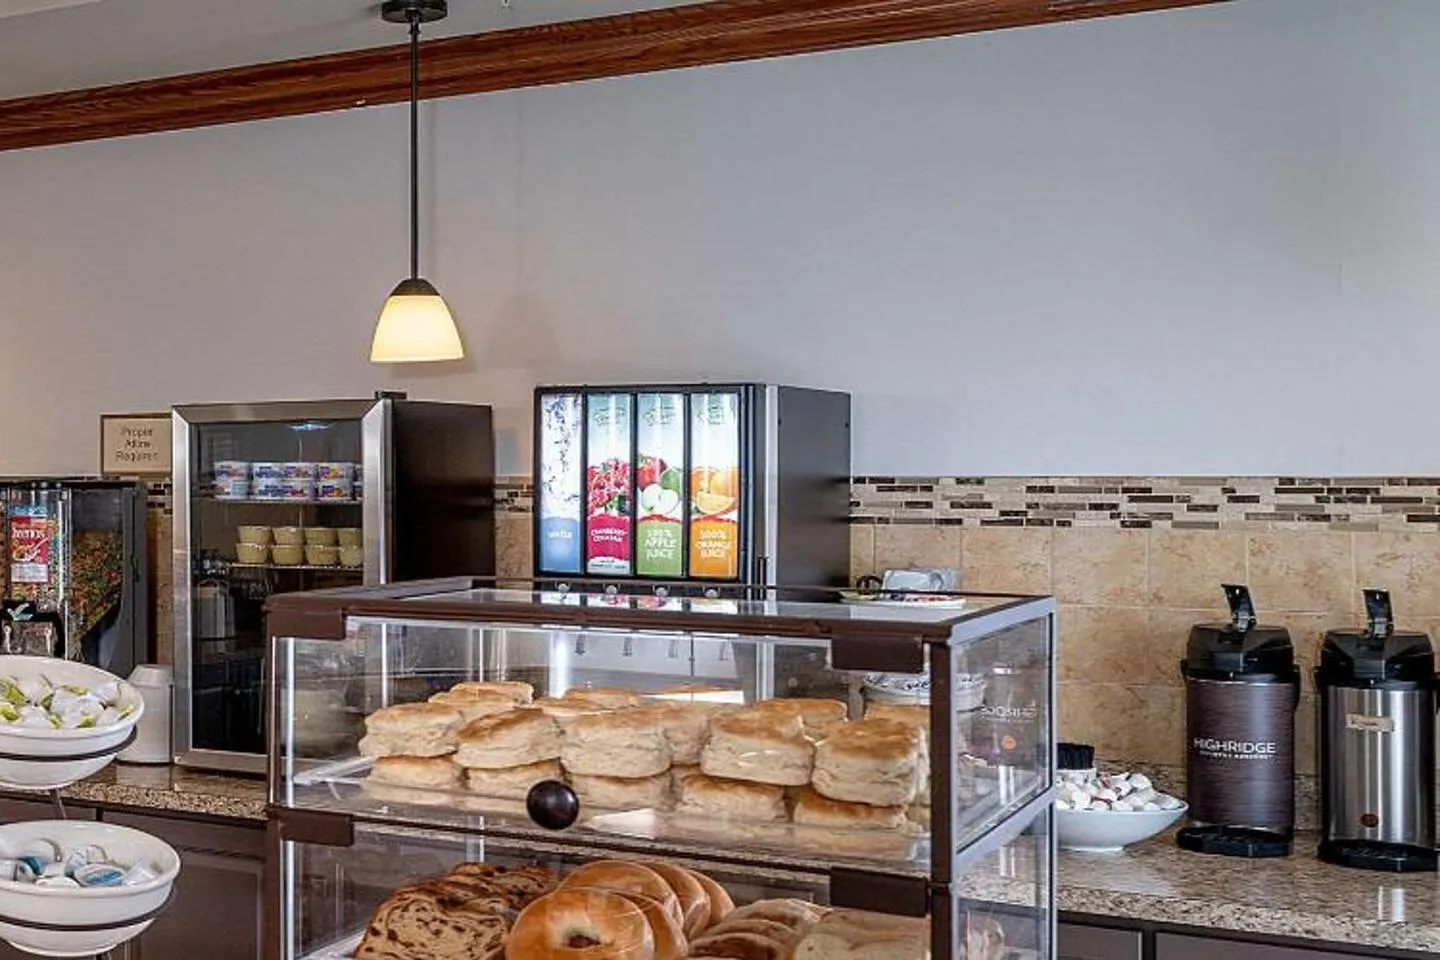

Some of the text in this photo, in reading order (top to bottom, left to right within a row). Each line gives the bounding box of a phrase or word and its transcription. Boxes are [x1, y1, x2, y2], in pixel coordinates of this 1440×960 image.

[645, 538, 677, 549] APPLE
[646, 549, 673, 559] JUICE
[1193, 738, 1276, 753] HIGHRIDGE
